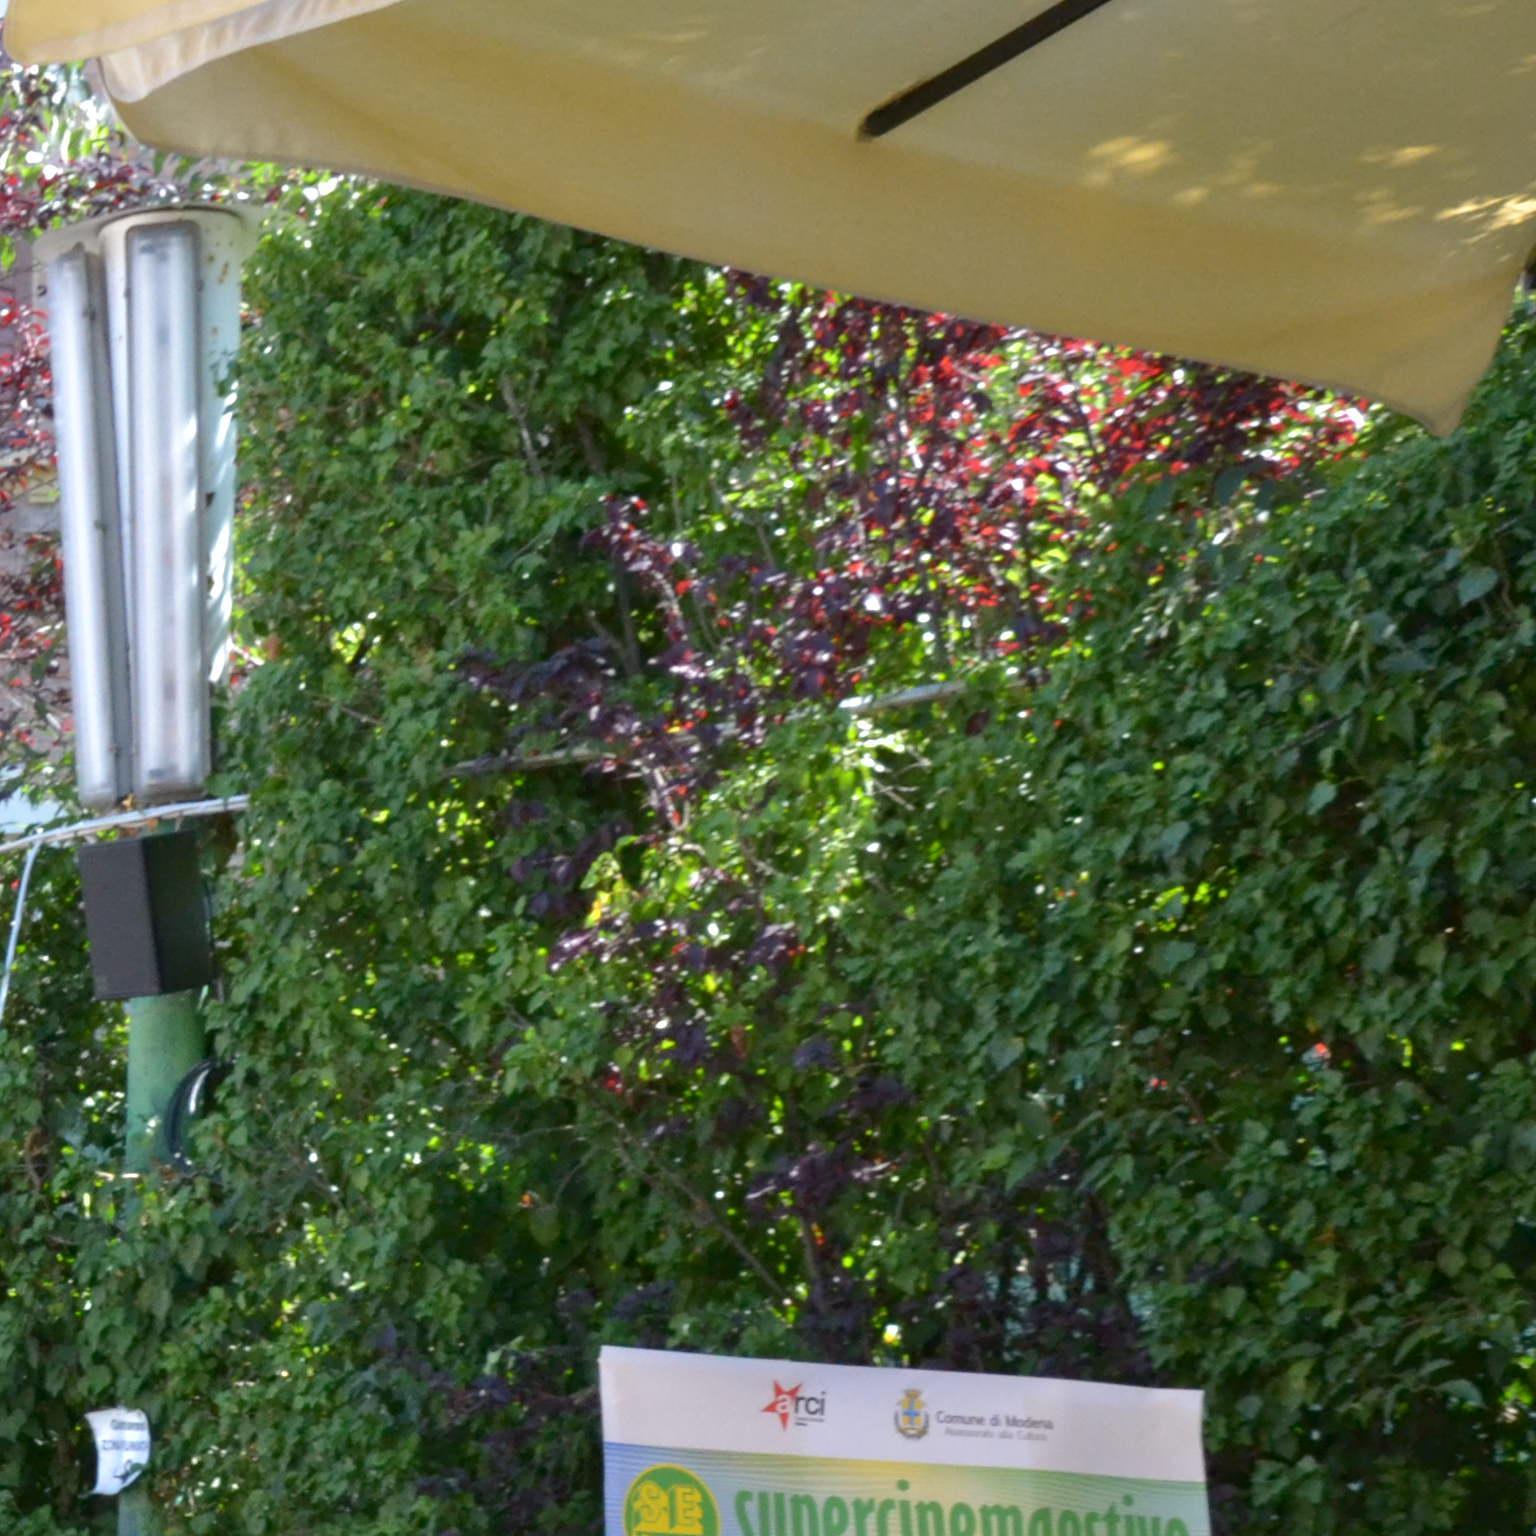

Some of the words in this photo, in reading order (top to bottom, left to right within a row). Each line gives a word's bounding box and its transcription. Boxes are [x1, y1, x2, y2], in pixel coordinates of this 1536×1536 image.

[775, 1390, 827, 1417] arci
[936, 1410, 985, 1426] Comune
[990, 1413, 1000, 1427] di
[1005, 1414, 1055, 1430] Modena
